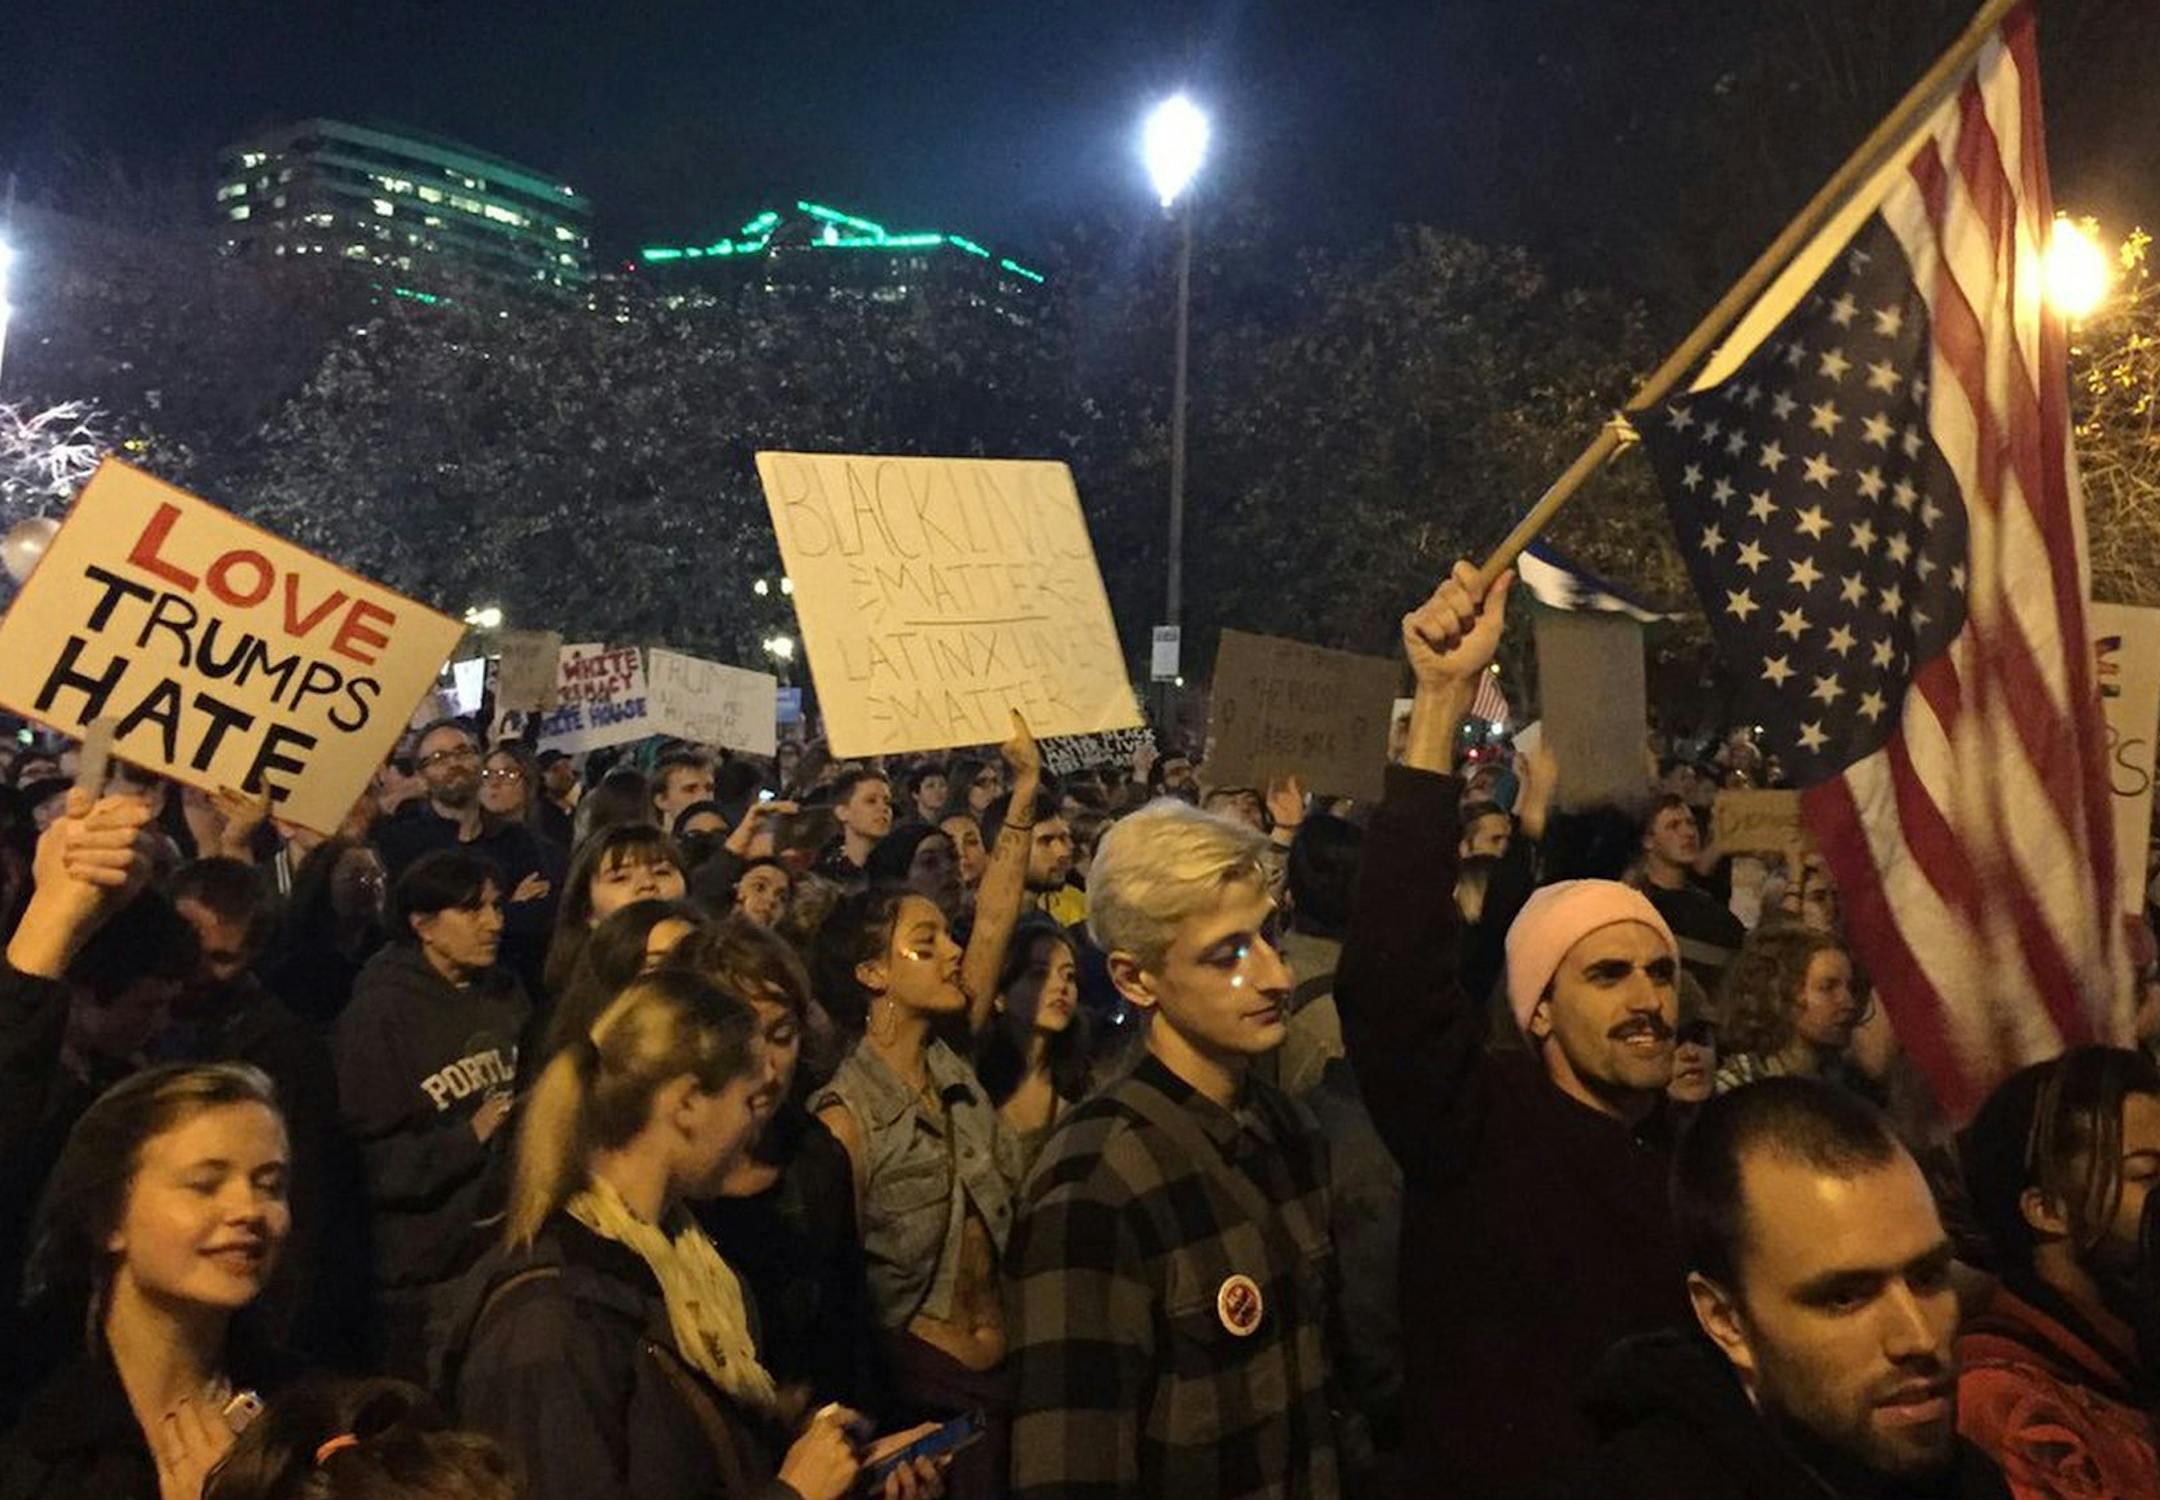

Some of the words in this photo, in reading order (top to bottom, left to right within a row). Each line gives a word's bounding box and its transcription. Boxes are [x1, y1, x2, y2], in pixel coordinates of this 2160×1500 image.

[772, 460, 964, 559] BLACK
[127, 502, 397, 667] LOVE
[874, 562, 1084, 614] MATTER
[85, 564, 381, 733] TRUMPS
[564, 649, 640, 681] WHITE
[836, 630, 1003, 683] LATINX
[34, 636, 319, 804] HATE
[590, 697, 648, 728] HOUSE
[886, 674, 1083, 742] MATTER
[420, 1044, 519, 1112] PORTL
